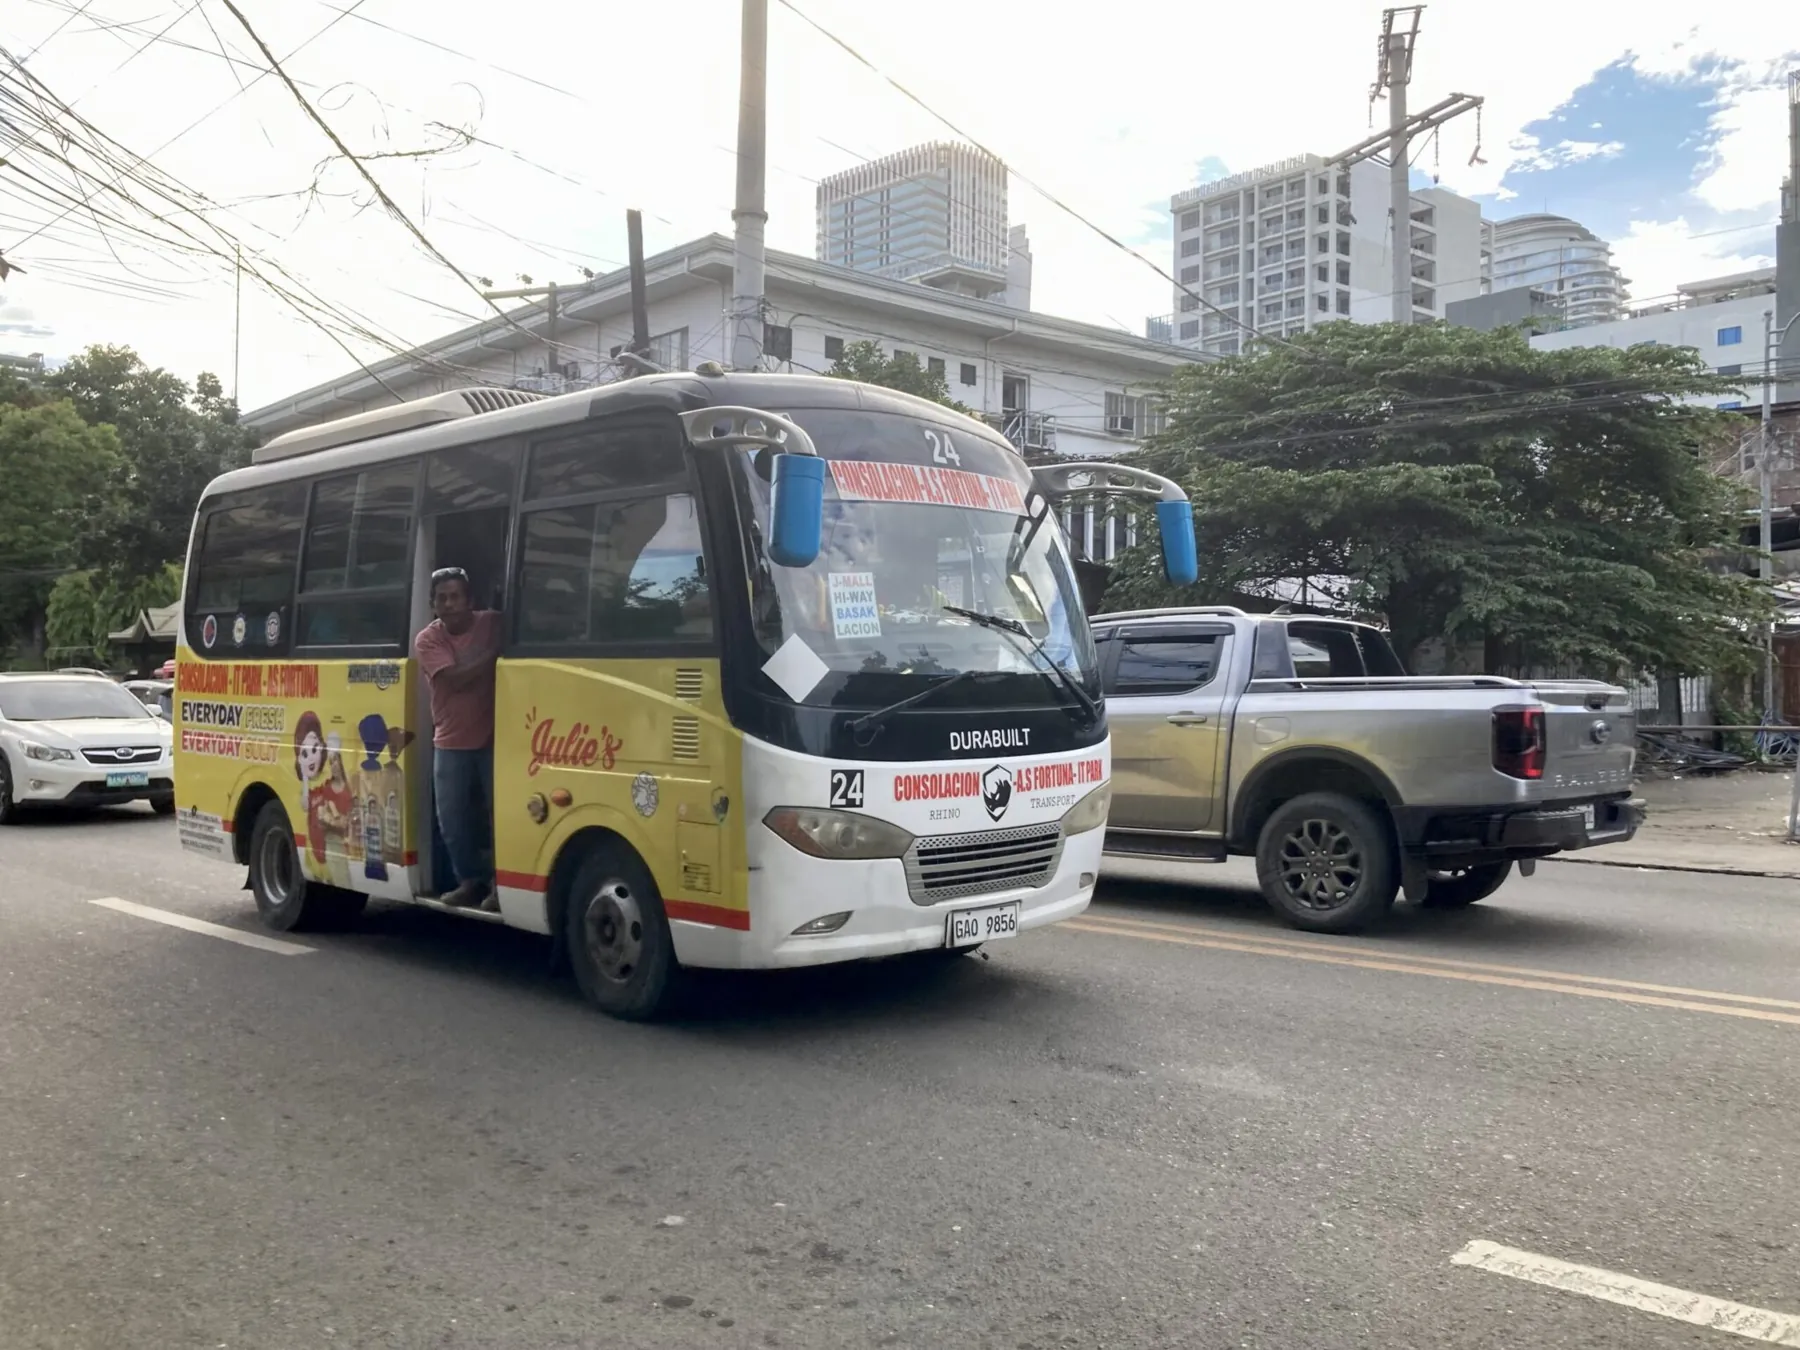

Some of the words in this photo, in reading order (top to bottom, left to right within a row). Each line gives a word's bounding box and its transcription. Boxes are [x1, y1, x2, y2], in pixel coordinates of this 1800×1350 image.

[924, 430, 961, 466] 24
[832, 575, 872, 588] J-MALL
[834, 590, 873, 604] HI-WAY
[836, 606, 876, 619] BASAK
[837, 622, 879, 636] LACION
[178, 662, 229, 695] CONSOLACION
[241, 664, 263, 697] PARK
[280, 664, 320, 699] FORTUNA
[181, 701, 243, 727] EVERYDAY
[245, 705, 285, 731] FRESH
[181, 730, 243, 757] EVERYDAY
[527, 718, 623, 777] Julie's
[950, 728, 1030, 750] DURABUILT
[831, 771, 863, 806] 24
[894, 771, 980, 802] CONSOLACION
[1078, 761, 1085, 784] IT
[1086, 759, 1103, 782] PARK
[929, 808, 961, 821] RHINO
[1030, 794, 1076, 809] TRANSPORT
[955, 920, 979, 939] GAO
[986, 913, 1016, 935] 9856
